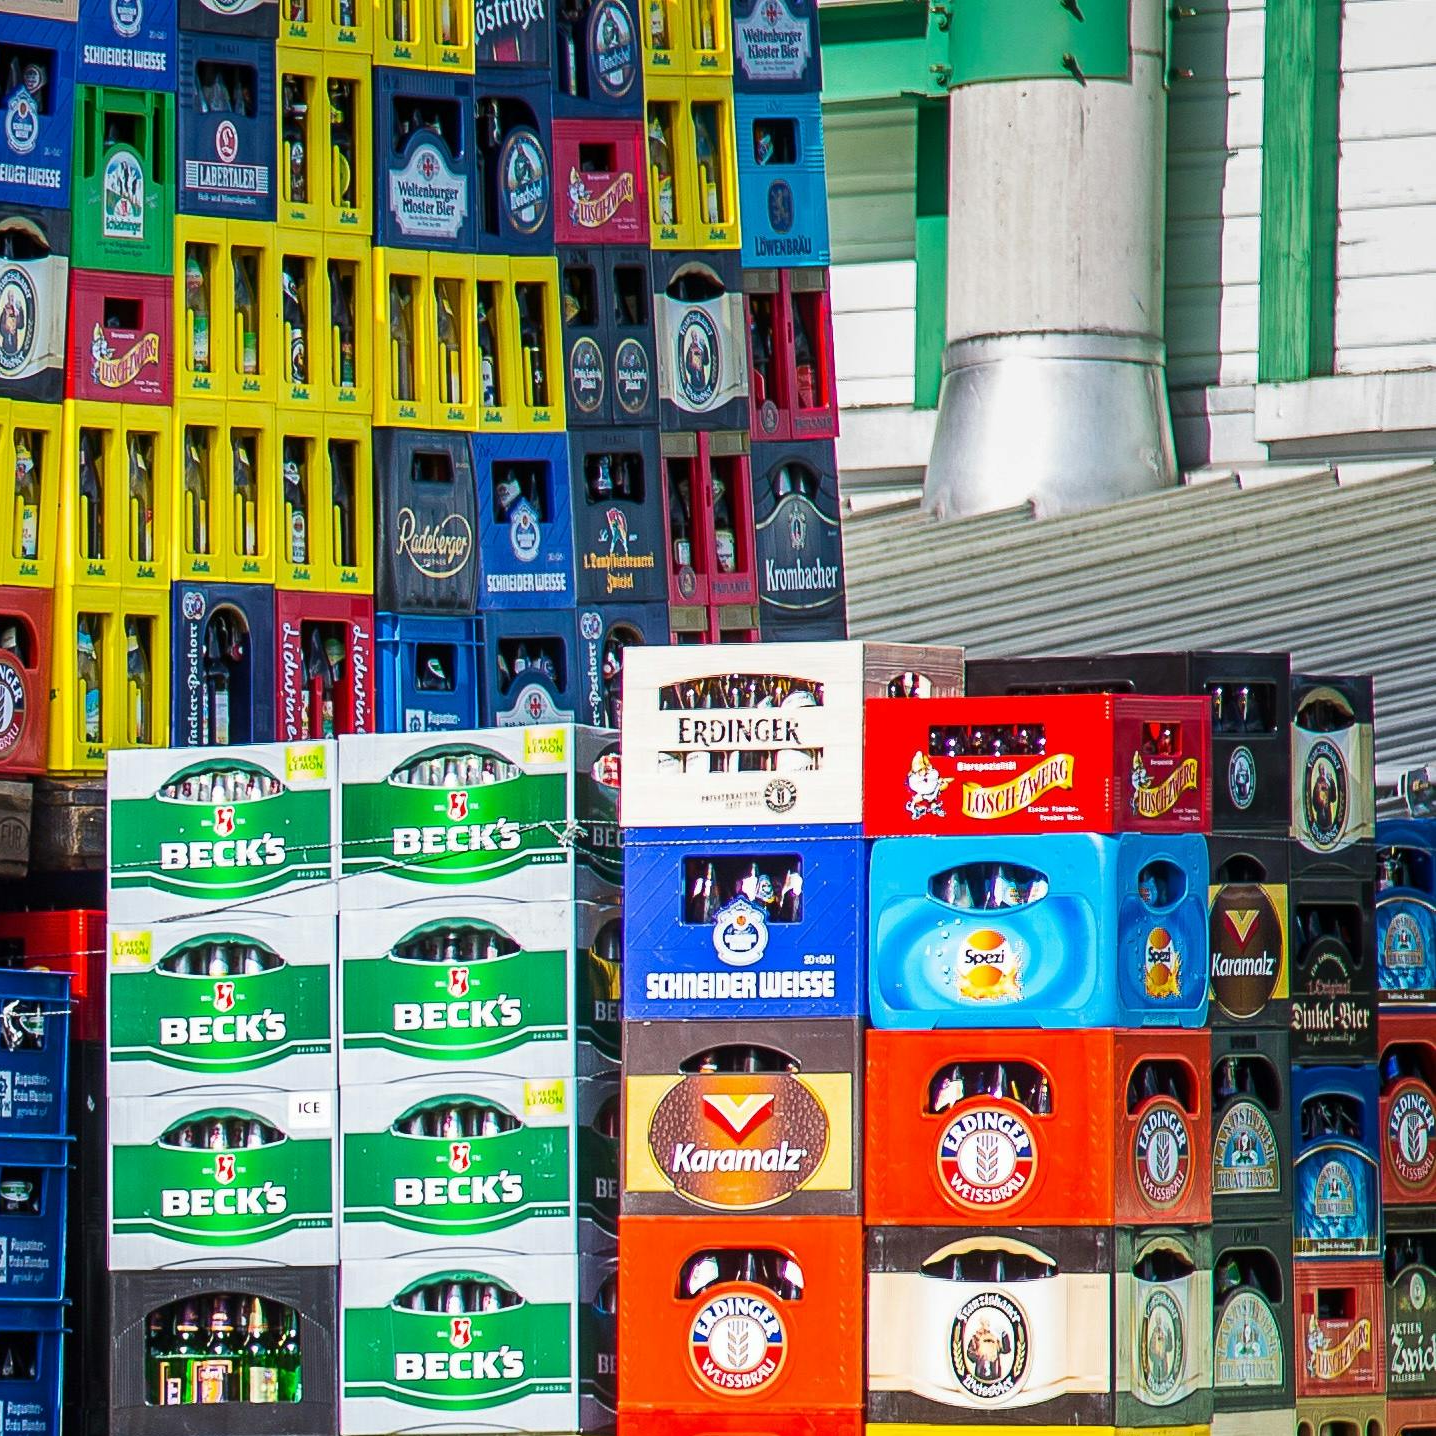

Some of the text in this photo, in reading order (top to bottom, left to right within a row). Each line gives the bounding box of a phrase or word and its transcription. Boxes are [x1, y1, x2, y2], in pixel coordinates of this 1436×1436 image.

[27, 167, 61, 189] WEISSE
[197, 166, 257, 190] LABERTALER
[398, 180, 459, 202] Weltenburger
[402, 197, 456, 217] Kloster Bier
[755, 235, 811, 256] LÖWENBRÄU
[397, 505, 468, 557] Radeberger
[527, 743, 564, 756] LEMON
[288, 760, 324, 773] LEMON
[964, 758, 1070, 817] LÖSCH-ZWERG
[160, 834, 286, 870] BECK'S
[965, 948, 1005, 966] Spezi
[1212, 951, 1275, 978] Karamalz
[646, 972, 835, 1000] SCHNEIDER WEISSE
[160, 1010, 287, 1044] BECK'S
[1291, 1003, 1370, 1033] Dinkel-Bier
[297, 1101, 321, 1114] ICE
[940, 1110, 1031, 1153] ERDINGER
[672, 1143, 807, 1174] Karamalz
[161, 1184, 287, 1218] BECK'S
